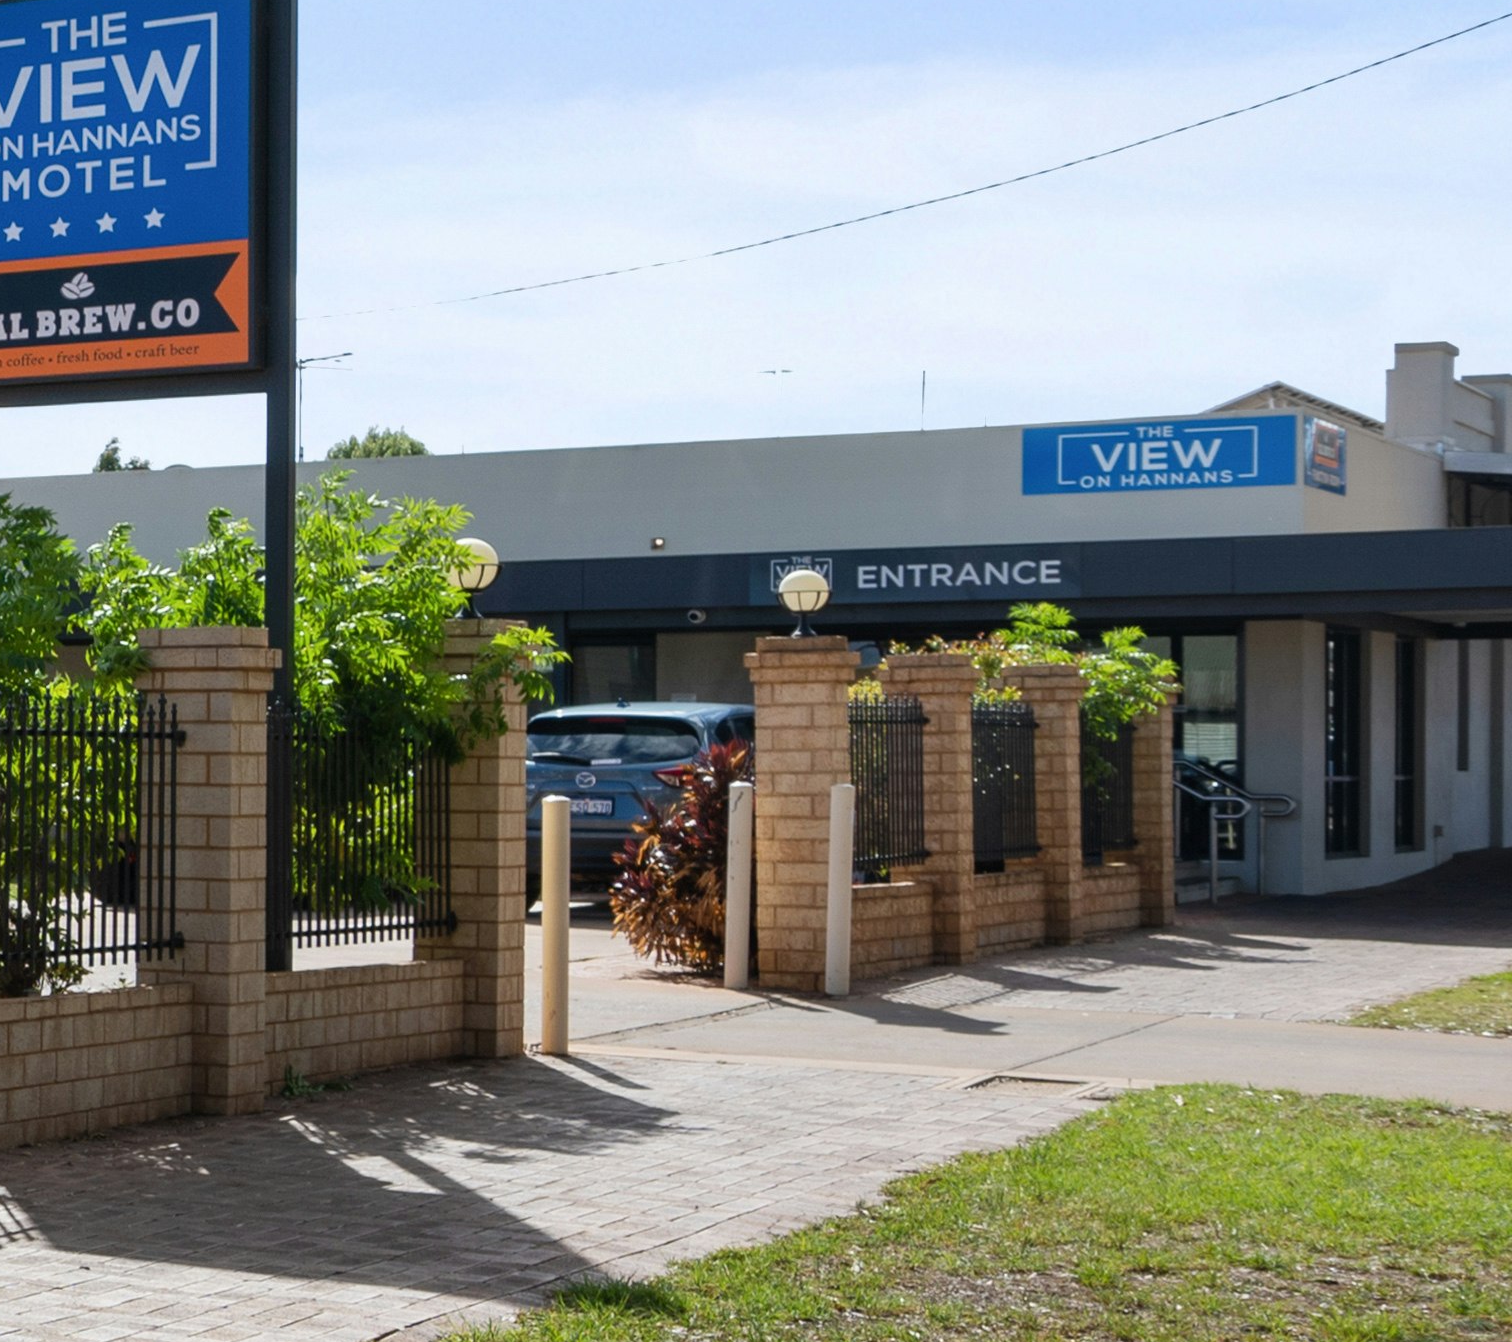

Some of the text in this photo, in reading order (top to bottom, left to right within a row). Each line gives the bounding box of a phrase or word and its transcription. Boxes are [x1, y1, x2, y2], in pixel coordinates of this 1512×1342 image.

[41, 11, 127, 53] THE
[32, 114, 201, 158] HANNANS
[2, 155, 167, 202] MOTEL
[36, 298, 200, 338] BREW.CO
[6, 353, 45, 367] coffee
[56, 350, 89, 364] fresh
[94, 347, 123, 360] food
[135, 345, 166, 358] craft
[170, 343, 200, 356] beer
[1136, 425, 1174, 438] THE
[1090, 438, 1223, 472] VIEW
[1079, 469, 1233, 489] ON HANNANS
[791, 555, 812, 564] THE
[857, 560, 1062, 589] ENTRANCE
